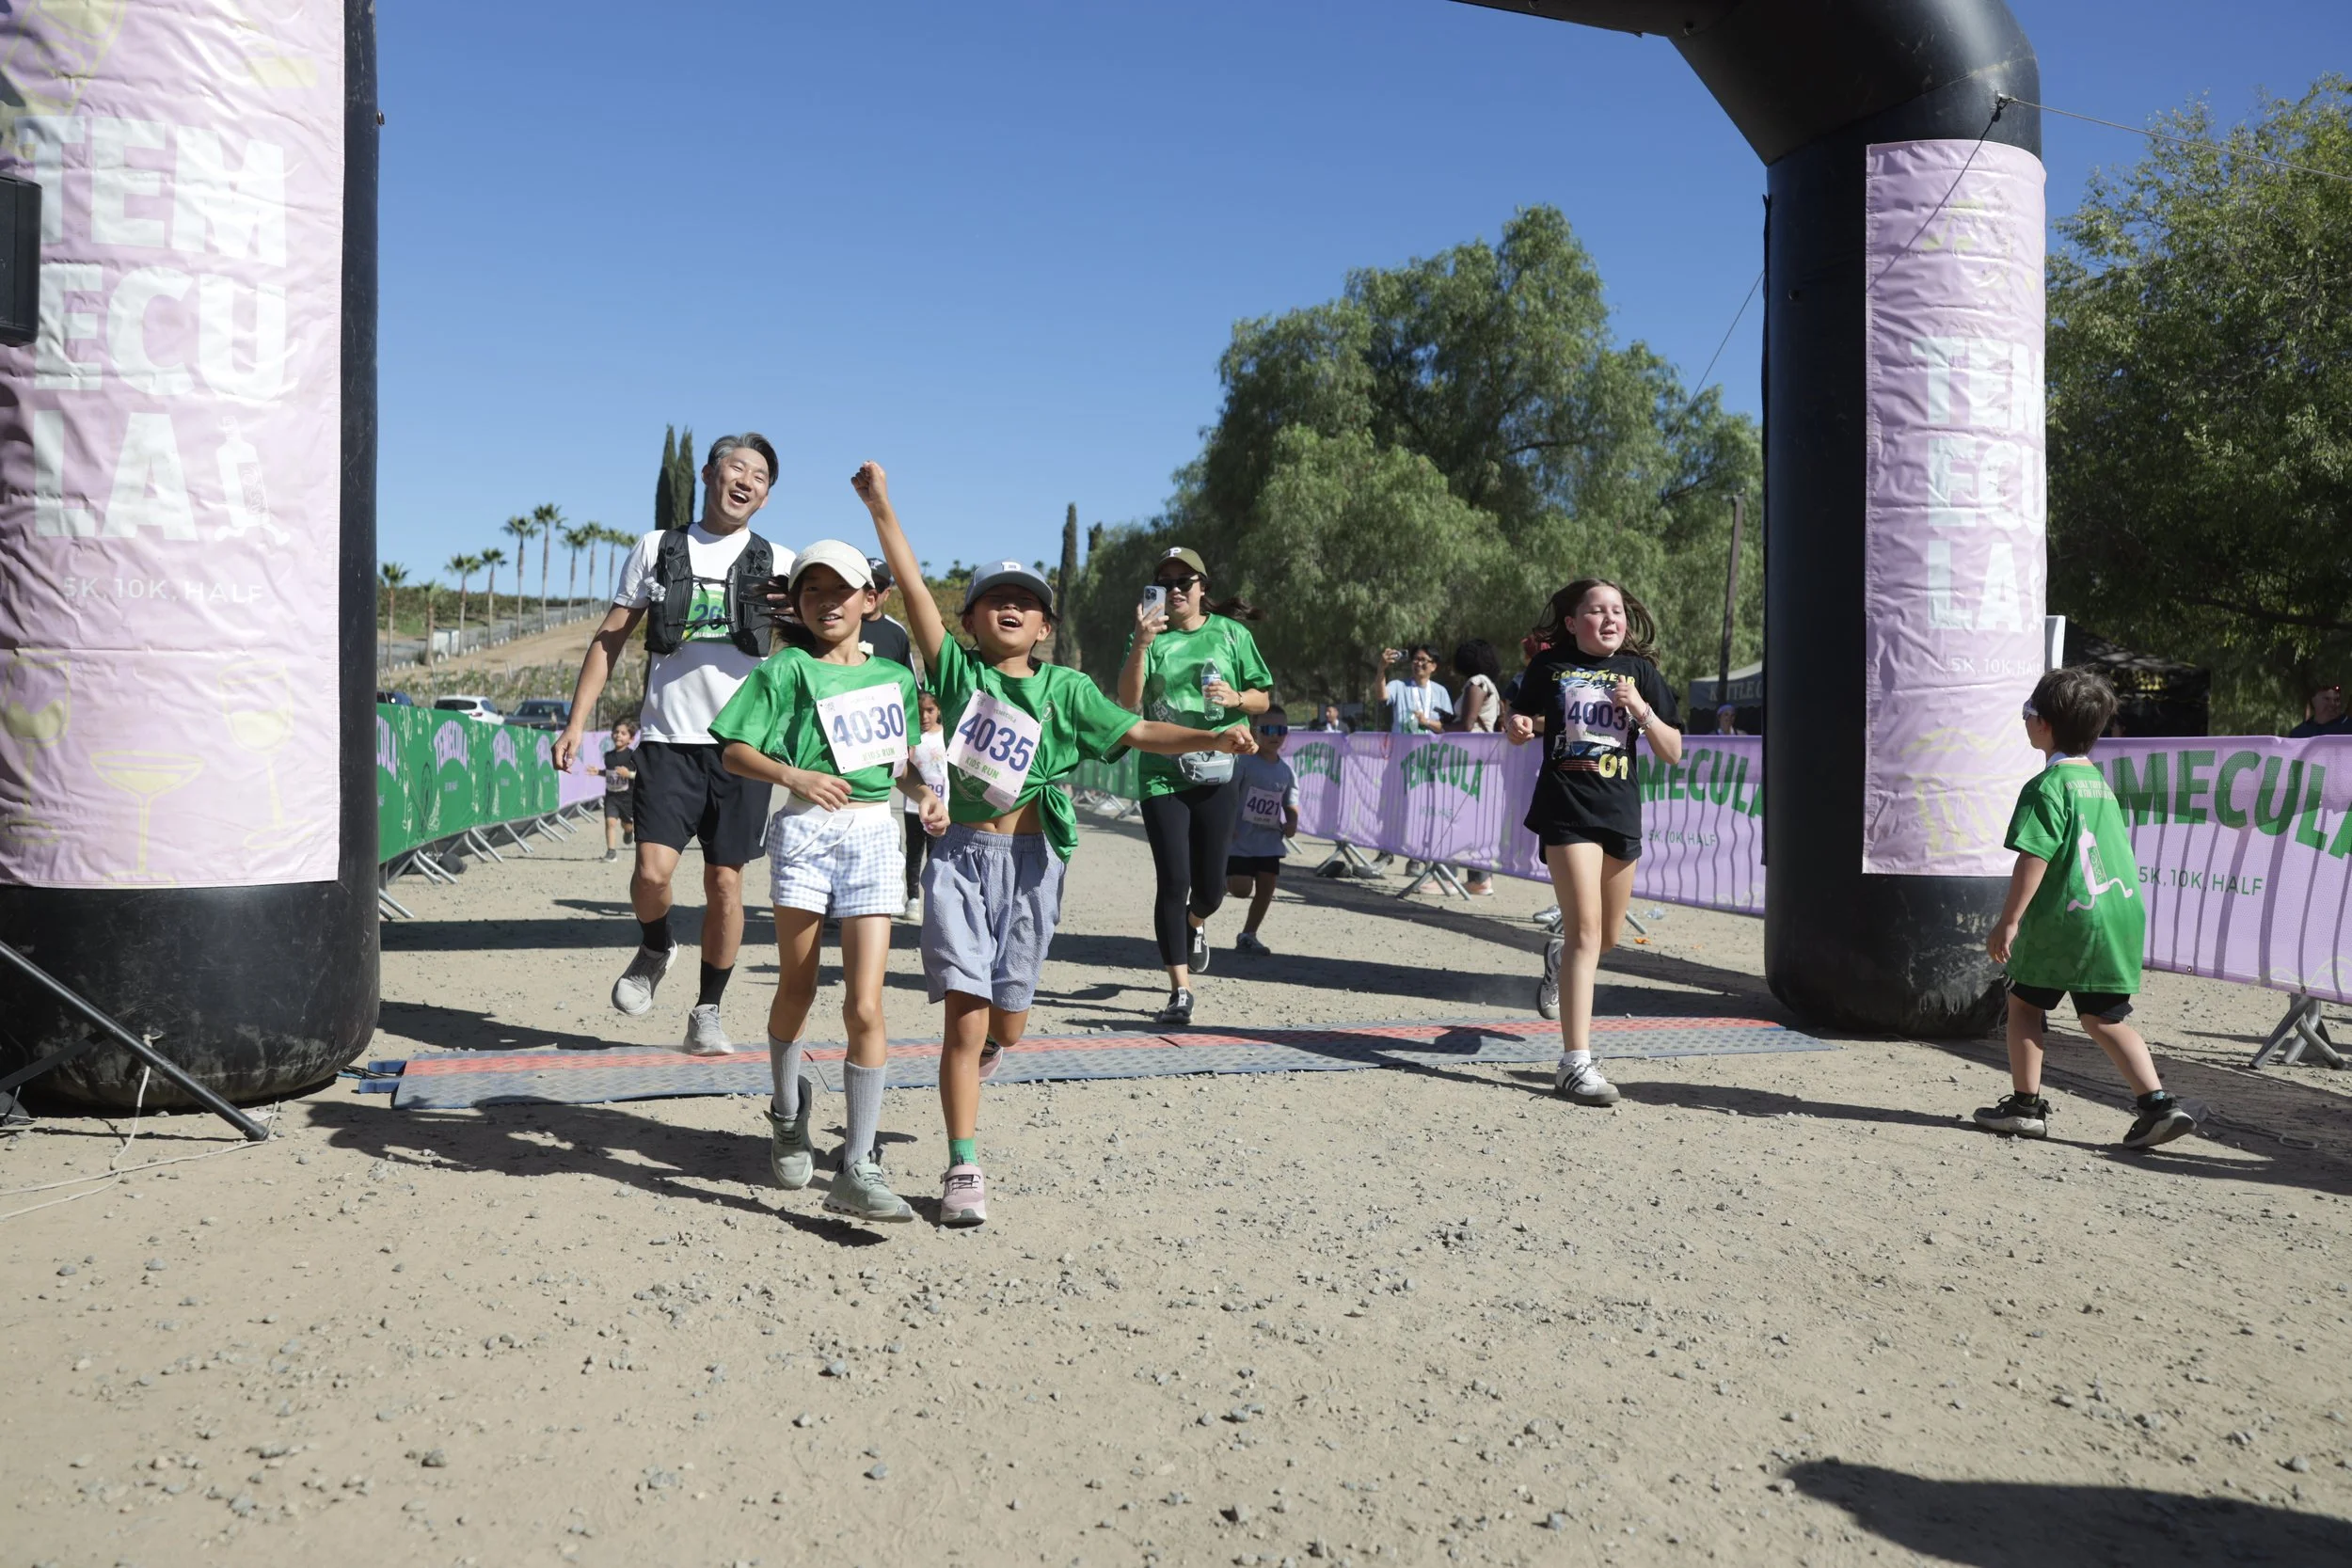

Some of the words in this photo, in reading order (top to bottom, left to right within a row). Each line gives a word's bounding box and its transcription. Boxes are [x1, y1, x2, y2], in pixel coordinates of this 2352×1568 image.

[14, 115, 286, 267] TEM
[35, 263, 296, 403] ECU
[34, 410, 198, 542] LA
[183, 580, 263, 604] HALF
[1929, 540, 2023, 632] LA
[1551, 670, 1635, 685] GOODYER
[1708, 680, 1756, 702] KTTLE
[832, 703, 904, 747] 4030
[1567, 701, 1628, 731] 4003
[959, 713, 1034, 772] 4035
[965, 756, 981, 770] KIDS
[982, 765, 1000, 780] RUN
[1400, 743, 1484, 802] TEMECULA
[1247, 796, 1280, 816] 4021
[2212, 874, 2264, 896] HALF
